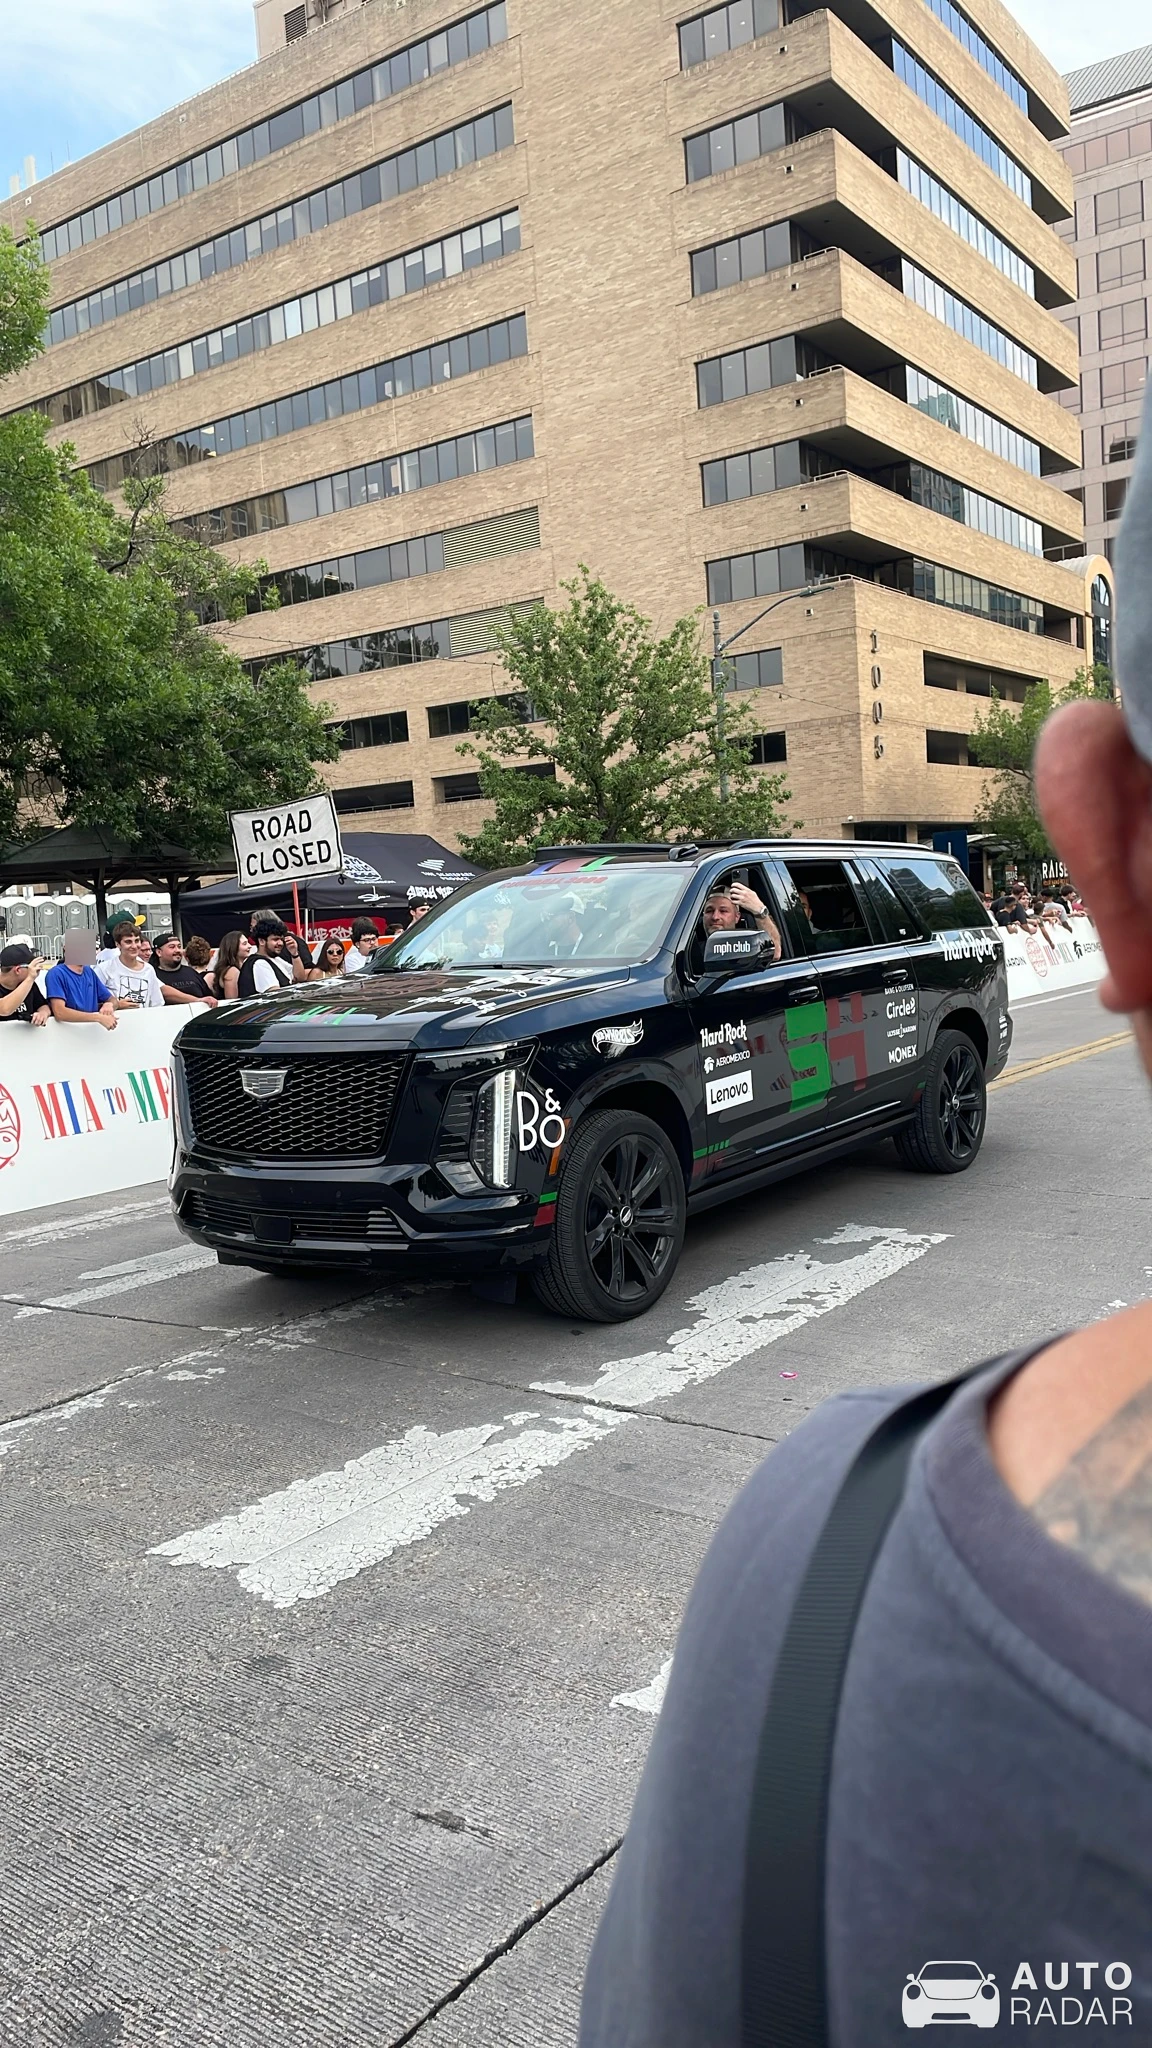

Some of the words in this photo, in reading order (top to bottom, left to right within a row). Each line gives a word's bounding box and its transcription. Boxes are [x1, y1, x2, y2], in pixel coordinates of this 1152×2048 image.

[252, 810, 312, 842] ROAD
[247, 840, 331, 876] CLOSED
[328, 925, 353, 940] RID
[713, 940, 732, 956] mph
[733, 940, 751, 953] club
[936, 931, 971, 961] Hard
[963, 929, 998, 963] Rock
[700, 1023, 725, 1048] Hard
[724, 1019, 748, 1045] Rock
[715, 1050, 751, 1067] AEROMEXICO
[888, 1044, 917, 1063] MONEX
[30, 1078, 105, 1141] MIA
[102, 1086, 128, 1116] TO
[125, 1067, 170, 1124] ME
[710, 1081, 749, 1104] Lenovo
